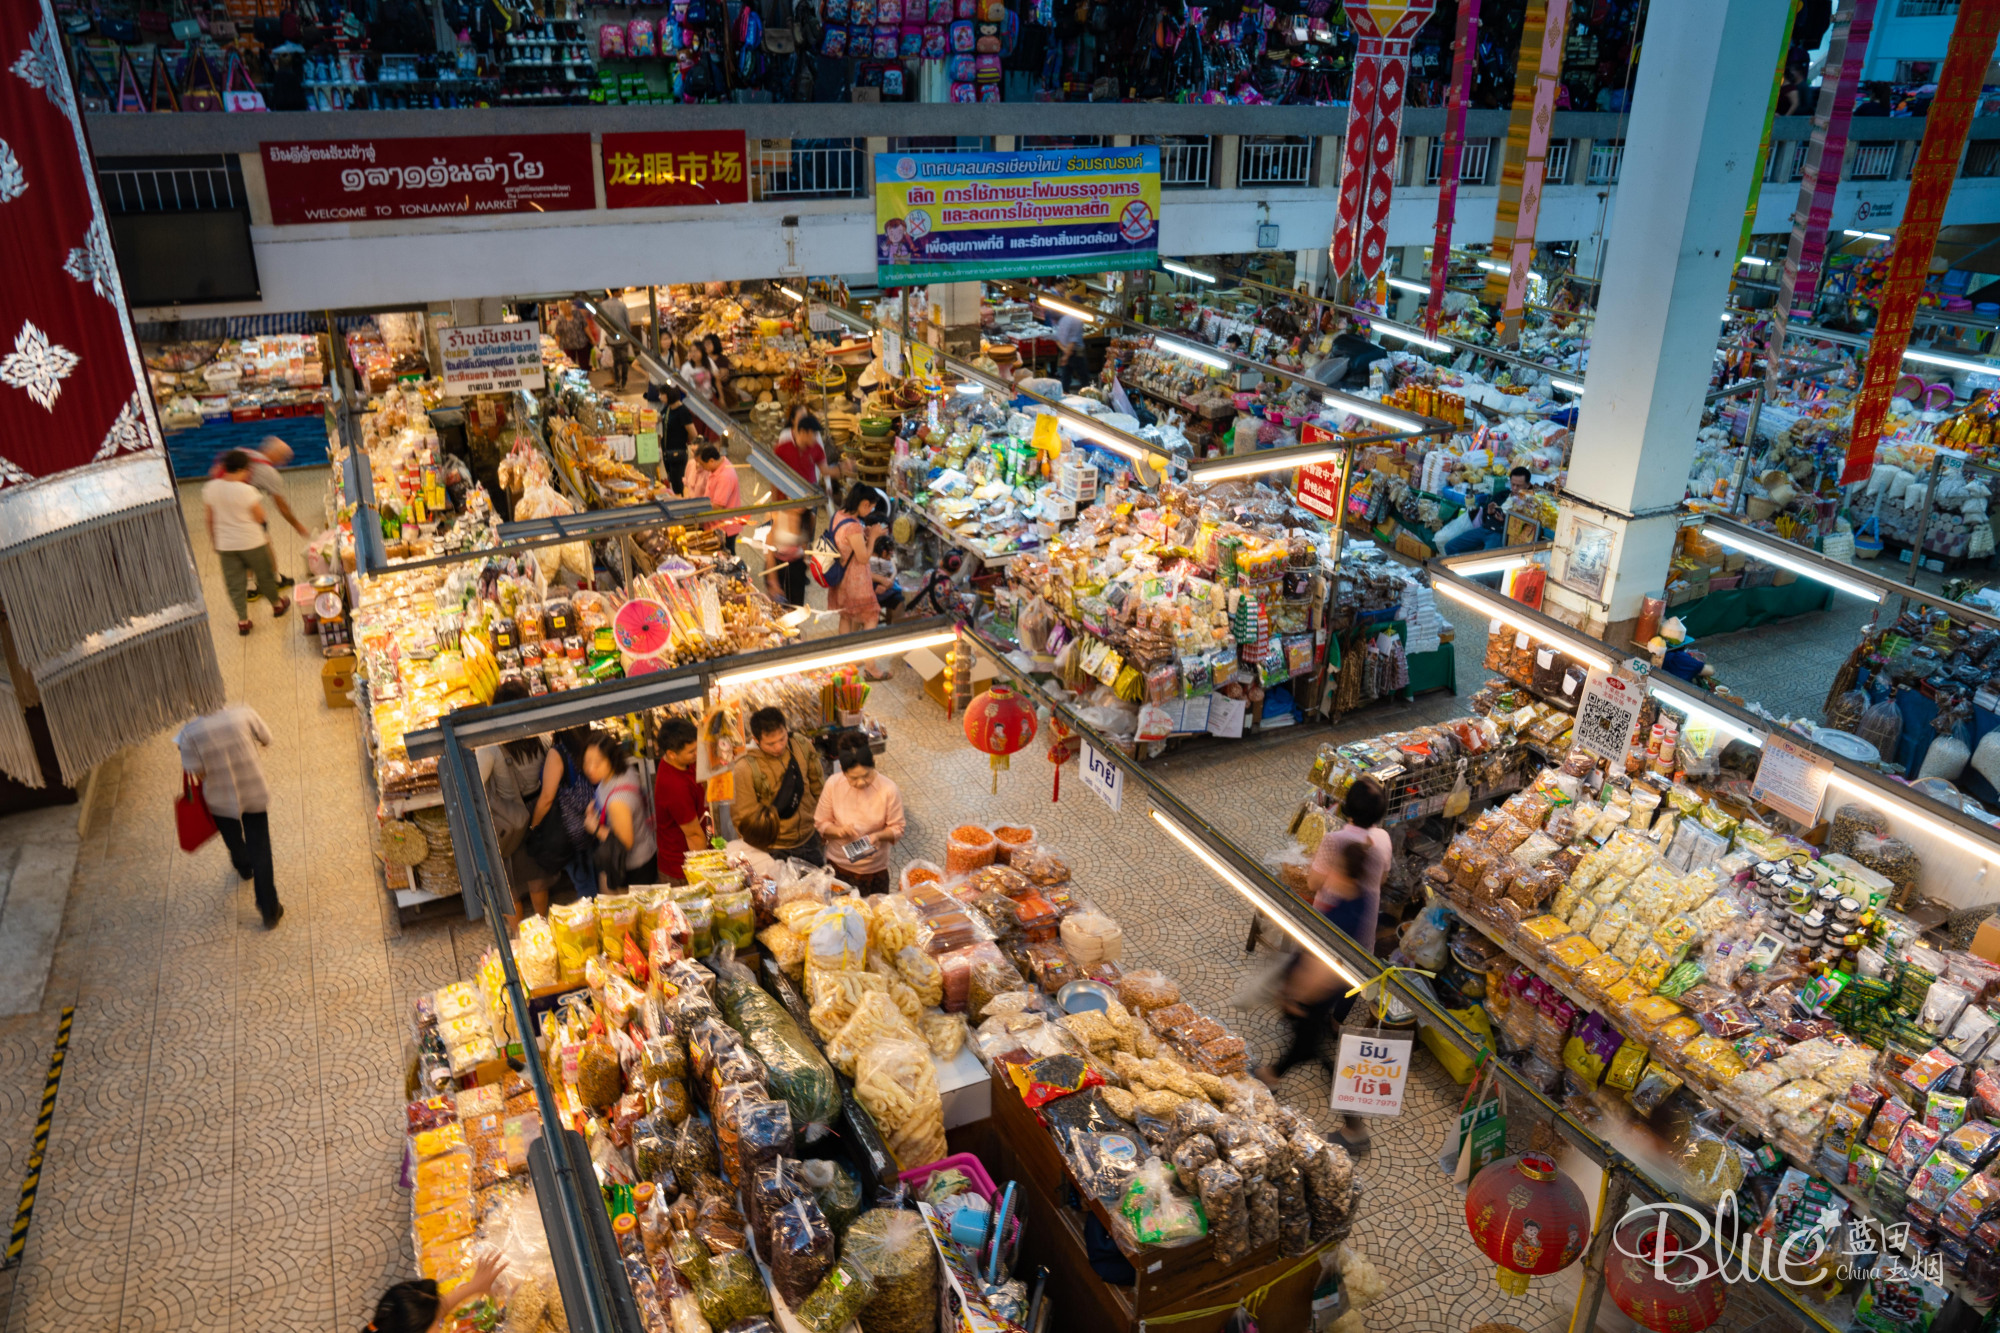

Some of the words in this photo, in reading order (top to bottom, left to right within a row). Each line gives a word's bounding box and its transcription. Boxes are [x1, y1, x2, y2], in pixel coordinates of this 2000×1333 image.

[341, 152, 544, 192] ตลาดต้นลำไย
[608, 150, 742, 187] 龙眼市场
[921, 154, 1062, 178] เทศบาลนครเชียงใหม่
[1066, 152, 1144, 172] ร่วมรณรงค์
[906, 185, 936, 206] เลิก
[942, 180, 1141, 205] การใช้ภาชนะโฟมบรรจุอาหาร
[304, 206, 367, 220] WELCOME
[374, 205, 392, 216] TO
[399, 202, 468, 215] TONLAMYAI
[475, 199, 519, 211] MARKET
[941, 199, 1111, 225] และลดการใช้ถุงพลาสติก
[924, 235, 1004, 256] เพื่อสุขภาพที่ดี
[1009, 230, 1118, 249] และรักษาสิ่งแวดล้อม
[448, 328, 532, 348] ร้านนันทนา
[1632, 659, 1648, 675] 56
[1359, 1041, 1388, 1059] ชิม
[1356, 1059, 1402, 1079] ช้อป
[1354, 1075, 1377, 1094] ใช้
[1338, 1094, 1355, 1102] 089
[1357, 1096, 1373, 1105] 192
[1375, 1099, 1397, 1107] 7979
